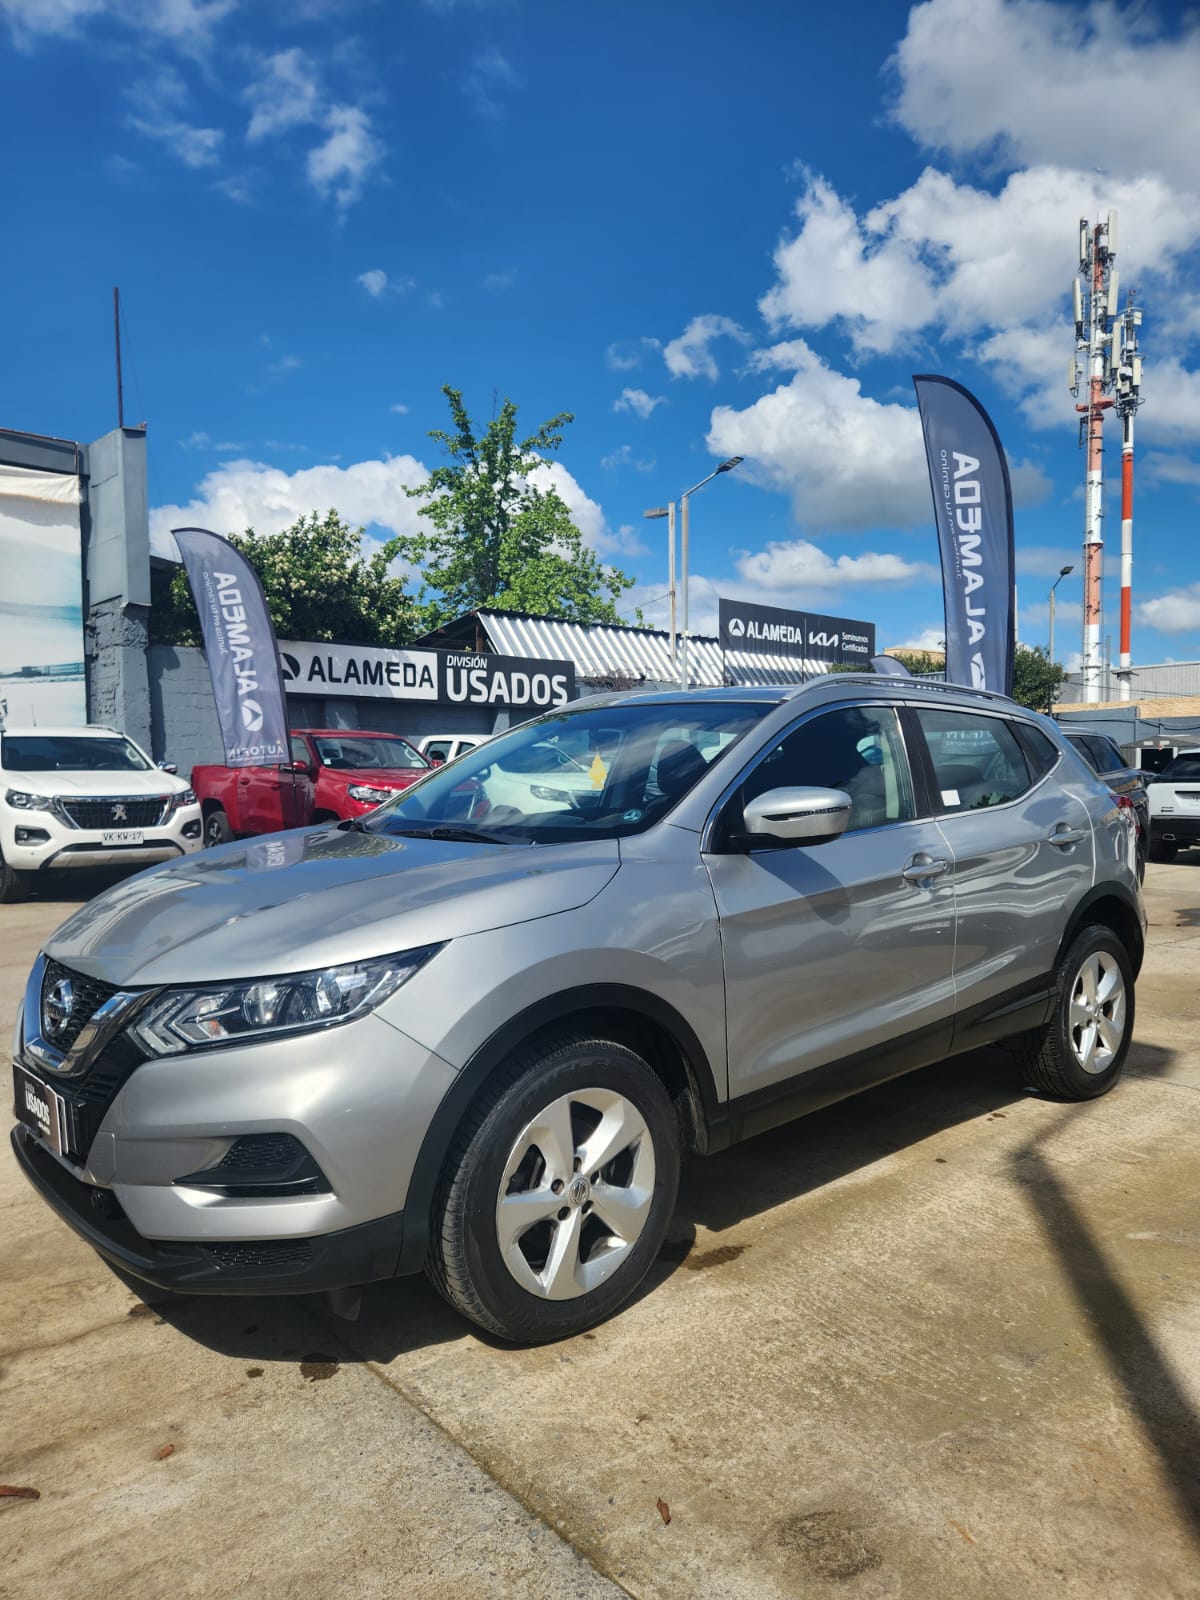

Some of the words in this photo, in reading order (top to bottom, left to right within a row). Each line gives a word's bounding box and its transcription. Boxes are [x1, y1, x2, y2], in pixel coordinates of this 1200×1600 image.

[746, 620, 803, 645] ALAMEDA
[841, 631, 869, 643] Seminuevos
[841, 643, 869, 653] Certificados
[307, 655, 436, 689] ALAMEDA
[446, 654, 487, 669] DIVISIÓN
[446, 668, 568, 706] USADOS
[25, 1091, 50, 1126] USADOS
